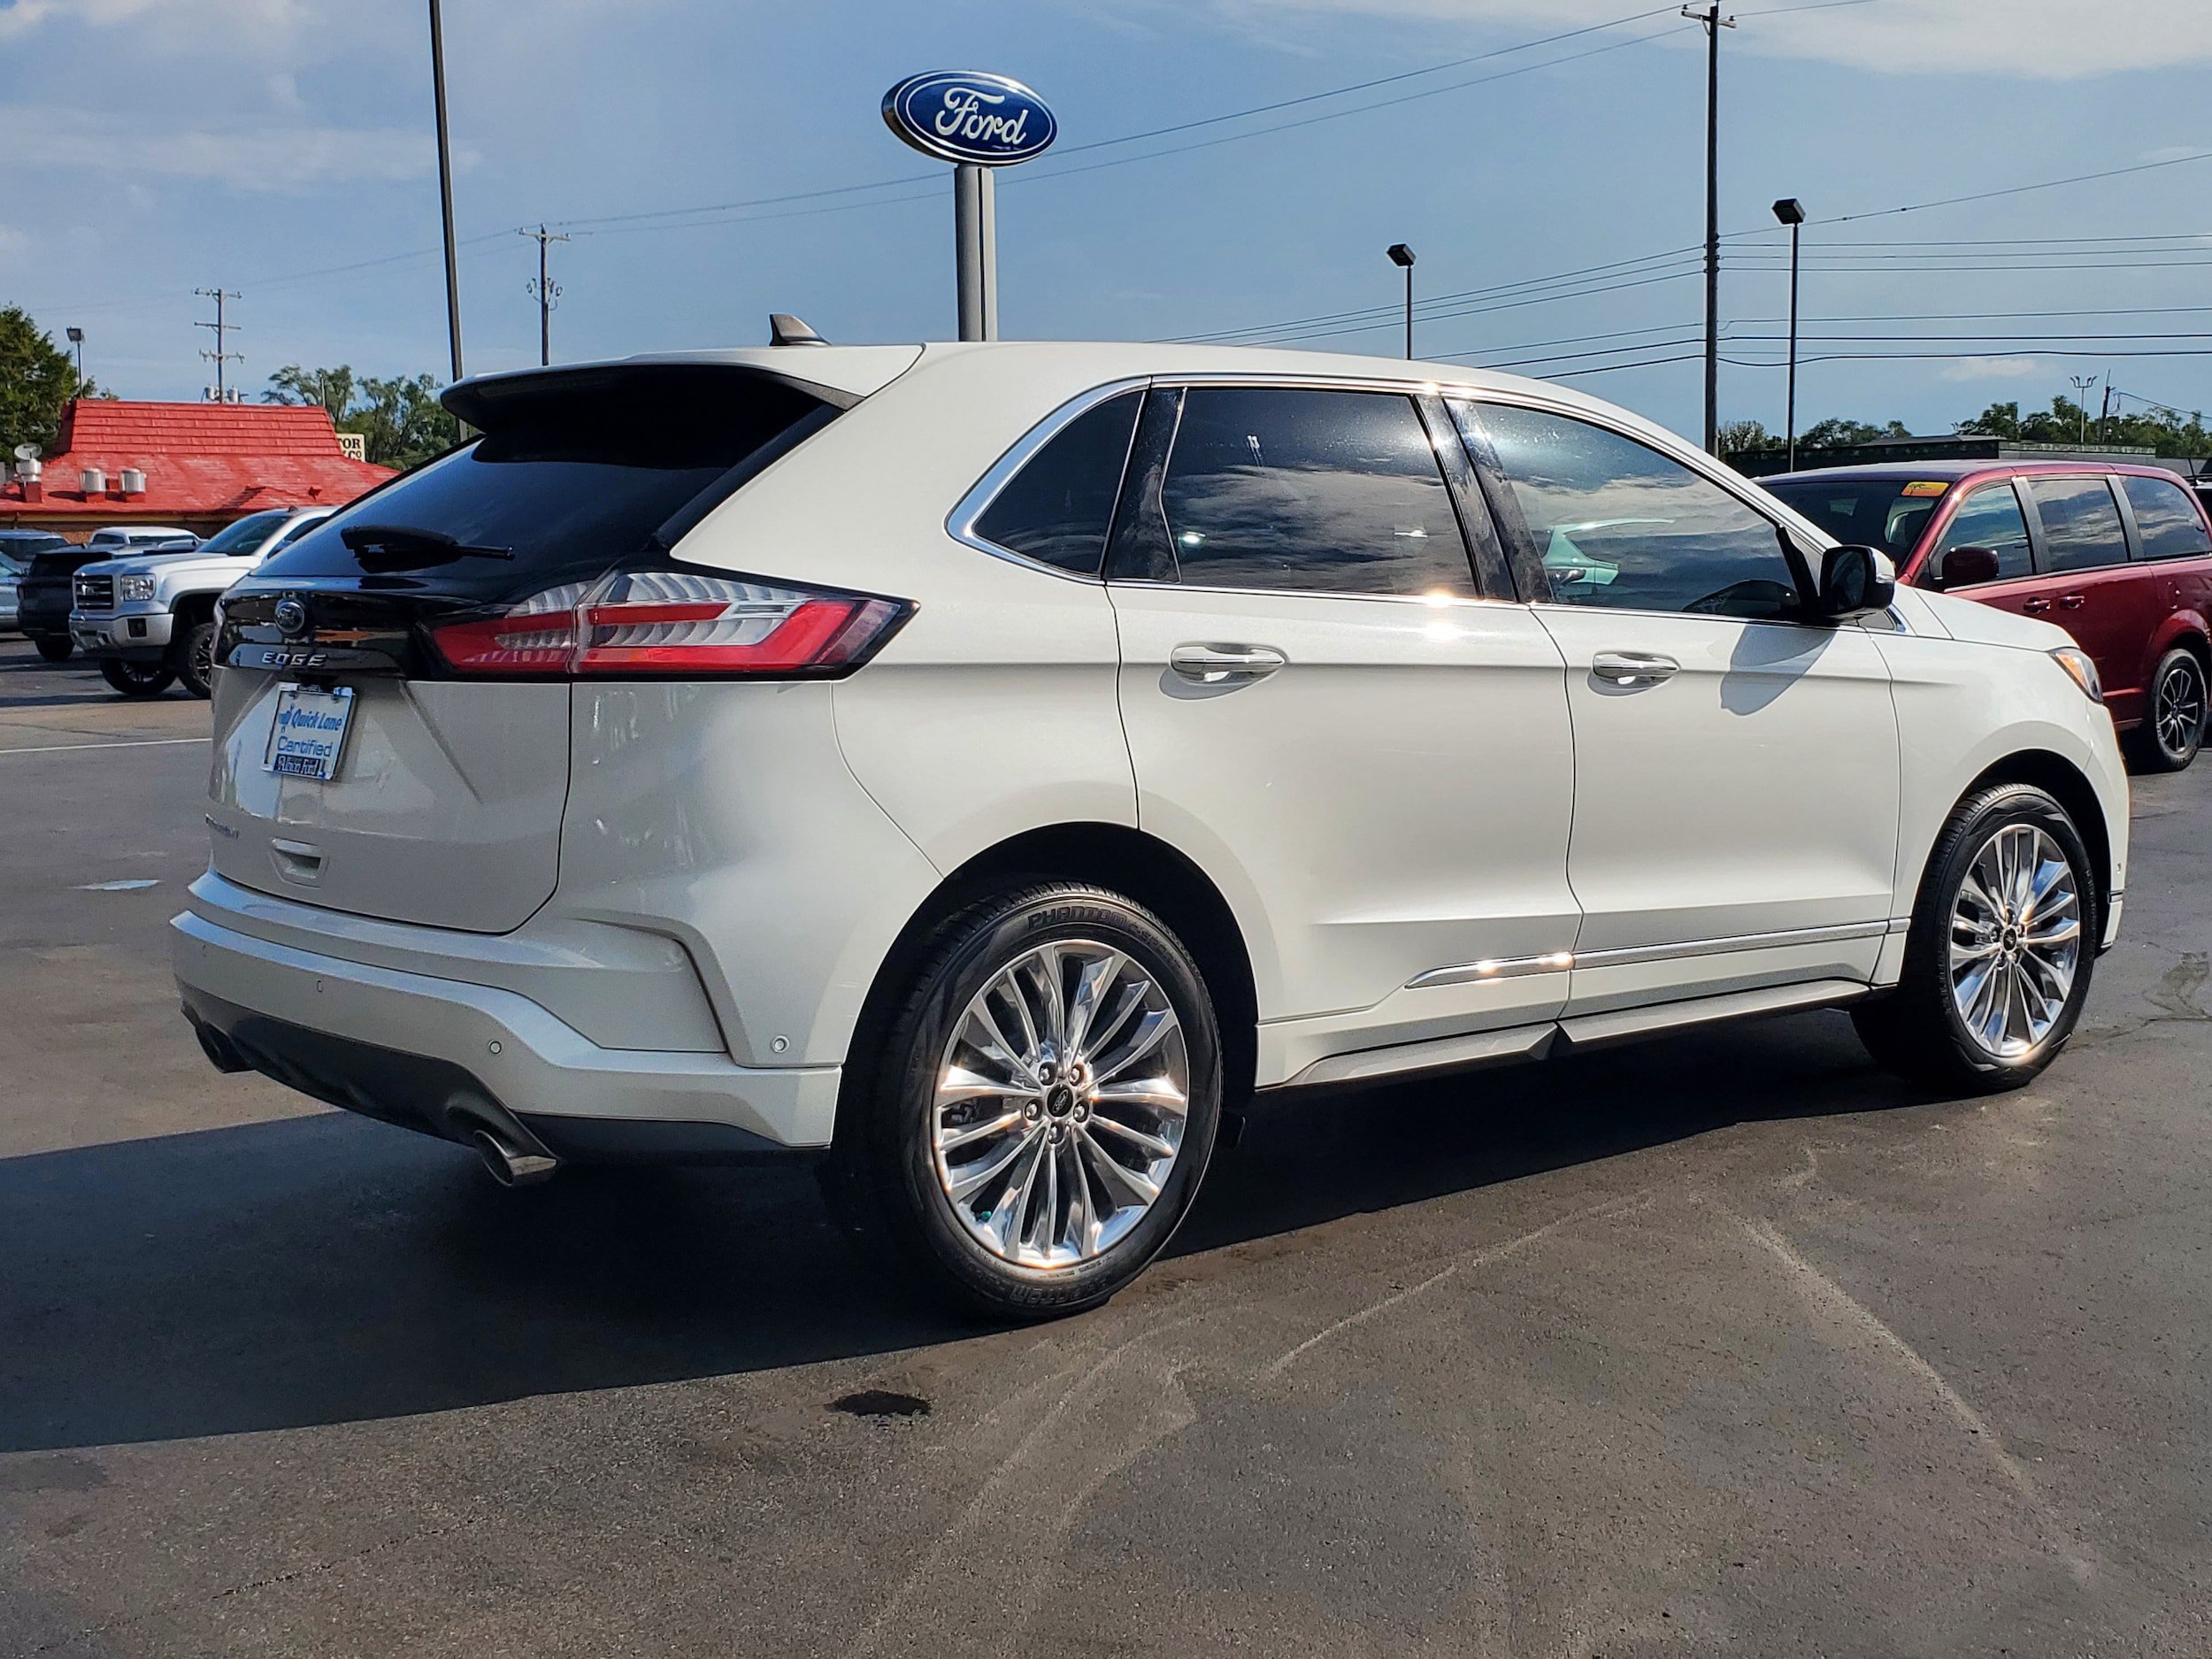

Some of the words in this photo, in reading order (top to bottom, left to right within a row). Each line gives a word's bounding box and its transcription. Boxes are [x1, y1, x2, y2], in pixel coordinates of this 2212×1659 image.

[934, 87, 1029, 145] Ford
[261, 651, 326, 666] EDGE
[291, 709, 319, 729] Quick
[317, 712, 342, 732] Lane
[277, 735, 334, 757] Certified
[1027, 905, 1127, 930] PHANTOM
